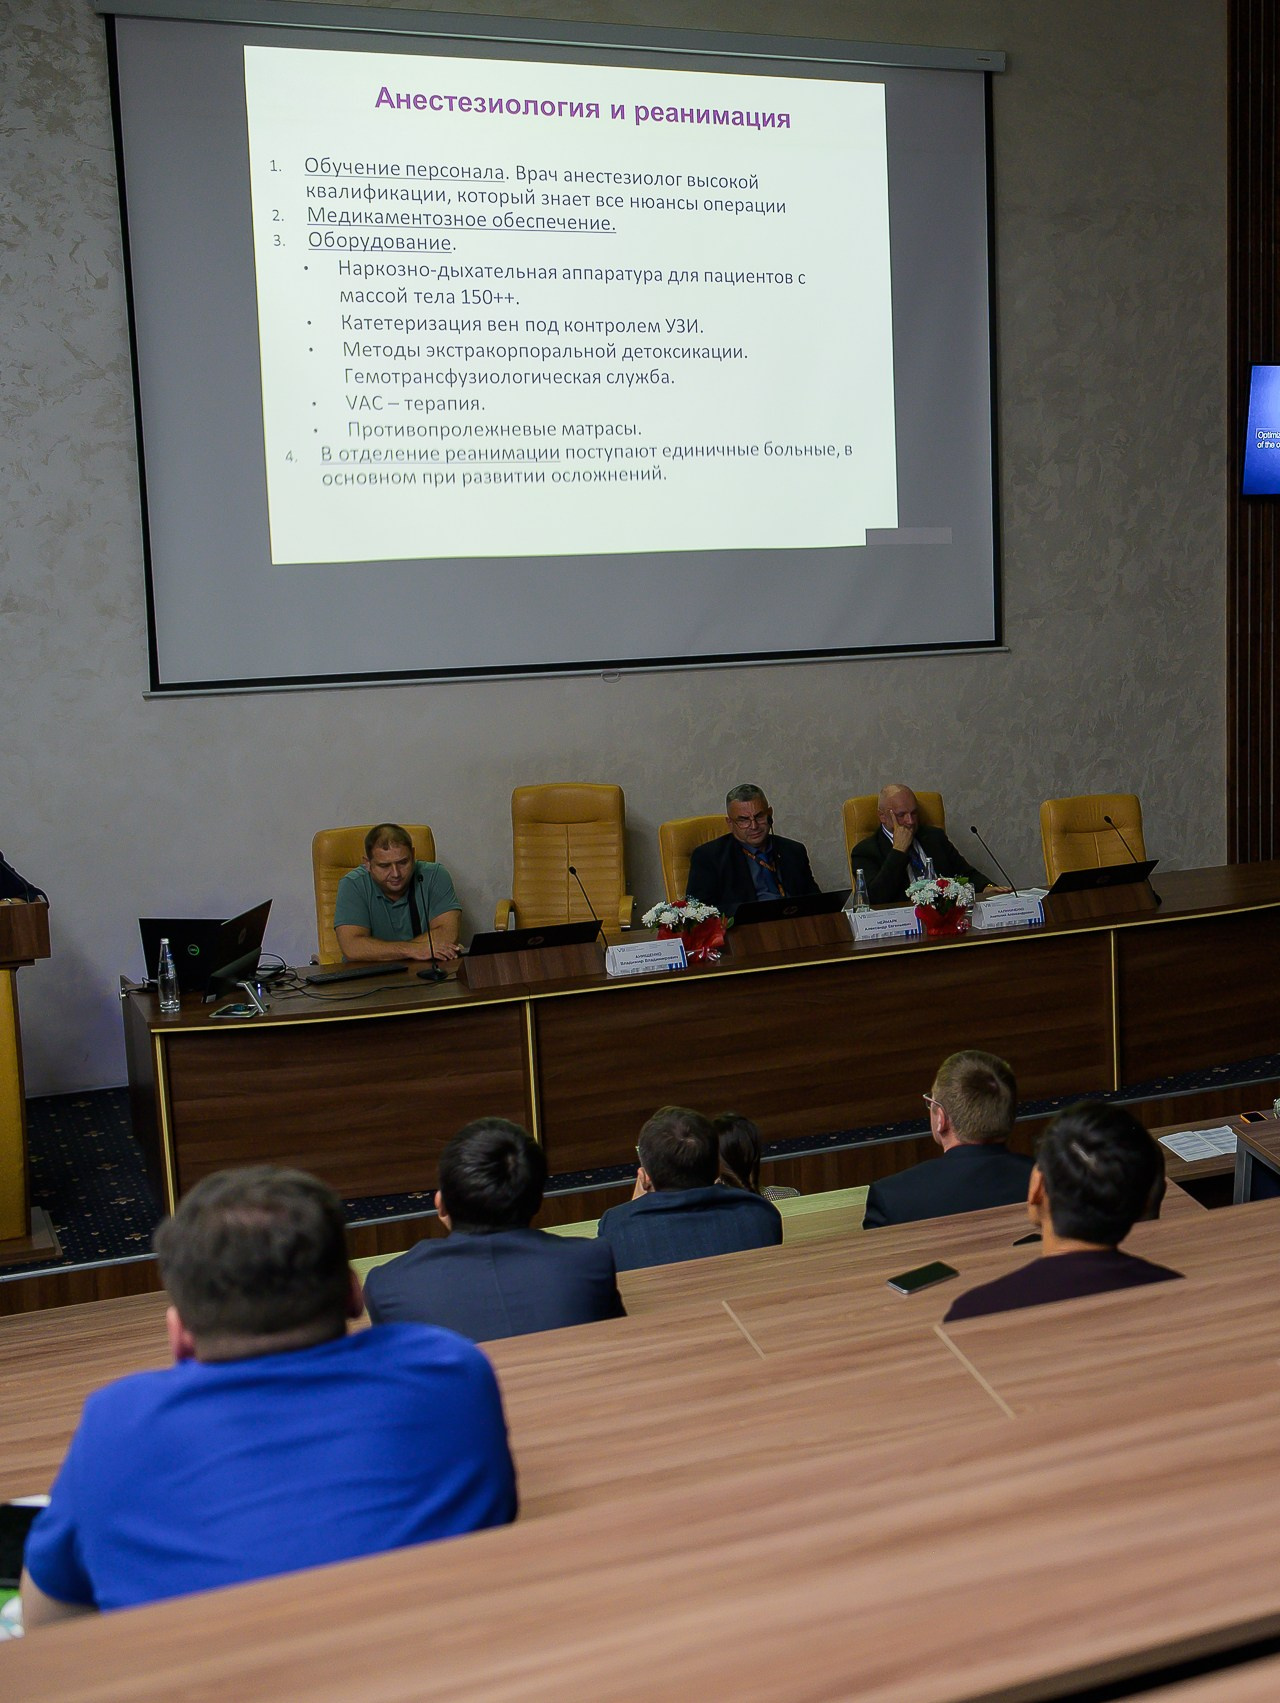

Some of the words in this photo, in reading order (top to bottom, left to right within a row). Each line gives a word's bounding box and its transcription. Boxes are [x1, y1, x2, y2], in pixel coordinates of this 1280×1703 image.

[374, 86, 600, 119] Анестезиология
[610, 103, 626, 121] и
[634, 104, 791, 131] реанимация
[269, 159, 282, 172] 1.
[304, 156, 401, 180] Обучение
[405, 164, 510, 184] персонала.
[515, 164, 558, 185] Врач
[563, 170, 683, 187] анестезиолог
[687, 173, 759, 190] высокой
[306, 185, 452, 206] квалификации,
[457, 190, 536, 209] который
[541, 193, 591, 207] знает
[595, 195, 624, 208] все
[629, 196, 699, 211] нюансы
[703, 199, 786, 217] операции
[271, 208, 285, 222] 2.
[307, 206, 487, 231] Медикаментозное
[492, 213, 616, 234] обеспечение.
[273, 233, 286, 247] 3.
[308, 231, 456, 254] Оборудование.
[338, 259, 558, 282] Наркозно-дыхательная
[562, 267, 663, 286] аппаратура
[667, 270, 699, 286] для
[704, 271, 794, 287] пациентов
[797, 273, 806, 285] с
[339, 287, 408, 304] массой
[413, 291, 456, 305] тела
[460, 288, 520, 306] 150++.
[341, 313, 482, 335] Катетеризация
[487, 319, 519, 332] вен
[525, 320, 560, 336] под
[564, 320, 661, 337] контролем
[664, 318, 704, 334] УЗИ.
[343, 341, 421, 361] Методы
[425, 342, 617, 363] экстракорпоральной
[621, 346, 748, 363] детоксикации.
[344, 367, 602, 389] Гемотрансфузиологическая
[606, 367, 675, 389] служба.
[345, 394, 384, 411] VAC
[403, 398, 485, 415] терапия.
[348, 421, 557, 441] Противопролежневые
[561, 423, 642, 440] матрасы.
[285, 450, 298, 462] 4.
[321, 446, 333, 463] В
[338, 448, 440, 465] отделение
[445, 447, 560, 465] реанимации
[565, 446, 658, 464] поступают
[662, 444, 760, 461] единичные
[763, 440, 840, 459] больные,
[844, 444, 853, 457] в
[1257, 440, 1265, 449] of
[1265, 440, 1275, 449] the
[321, 471, 417, 487] основном
[422, 471, 456, 489] при
[462, 470, 546, 489] развитии
[551, 463, 667, 483] осложнений.
